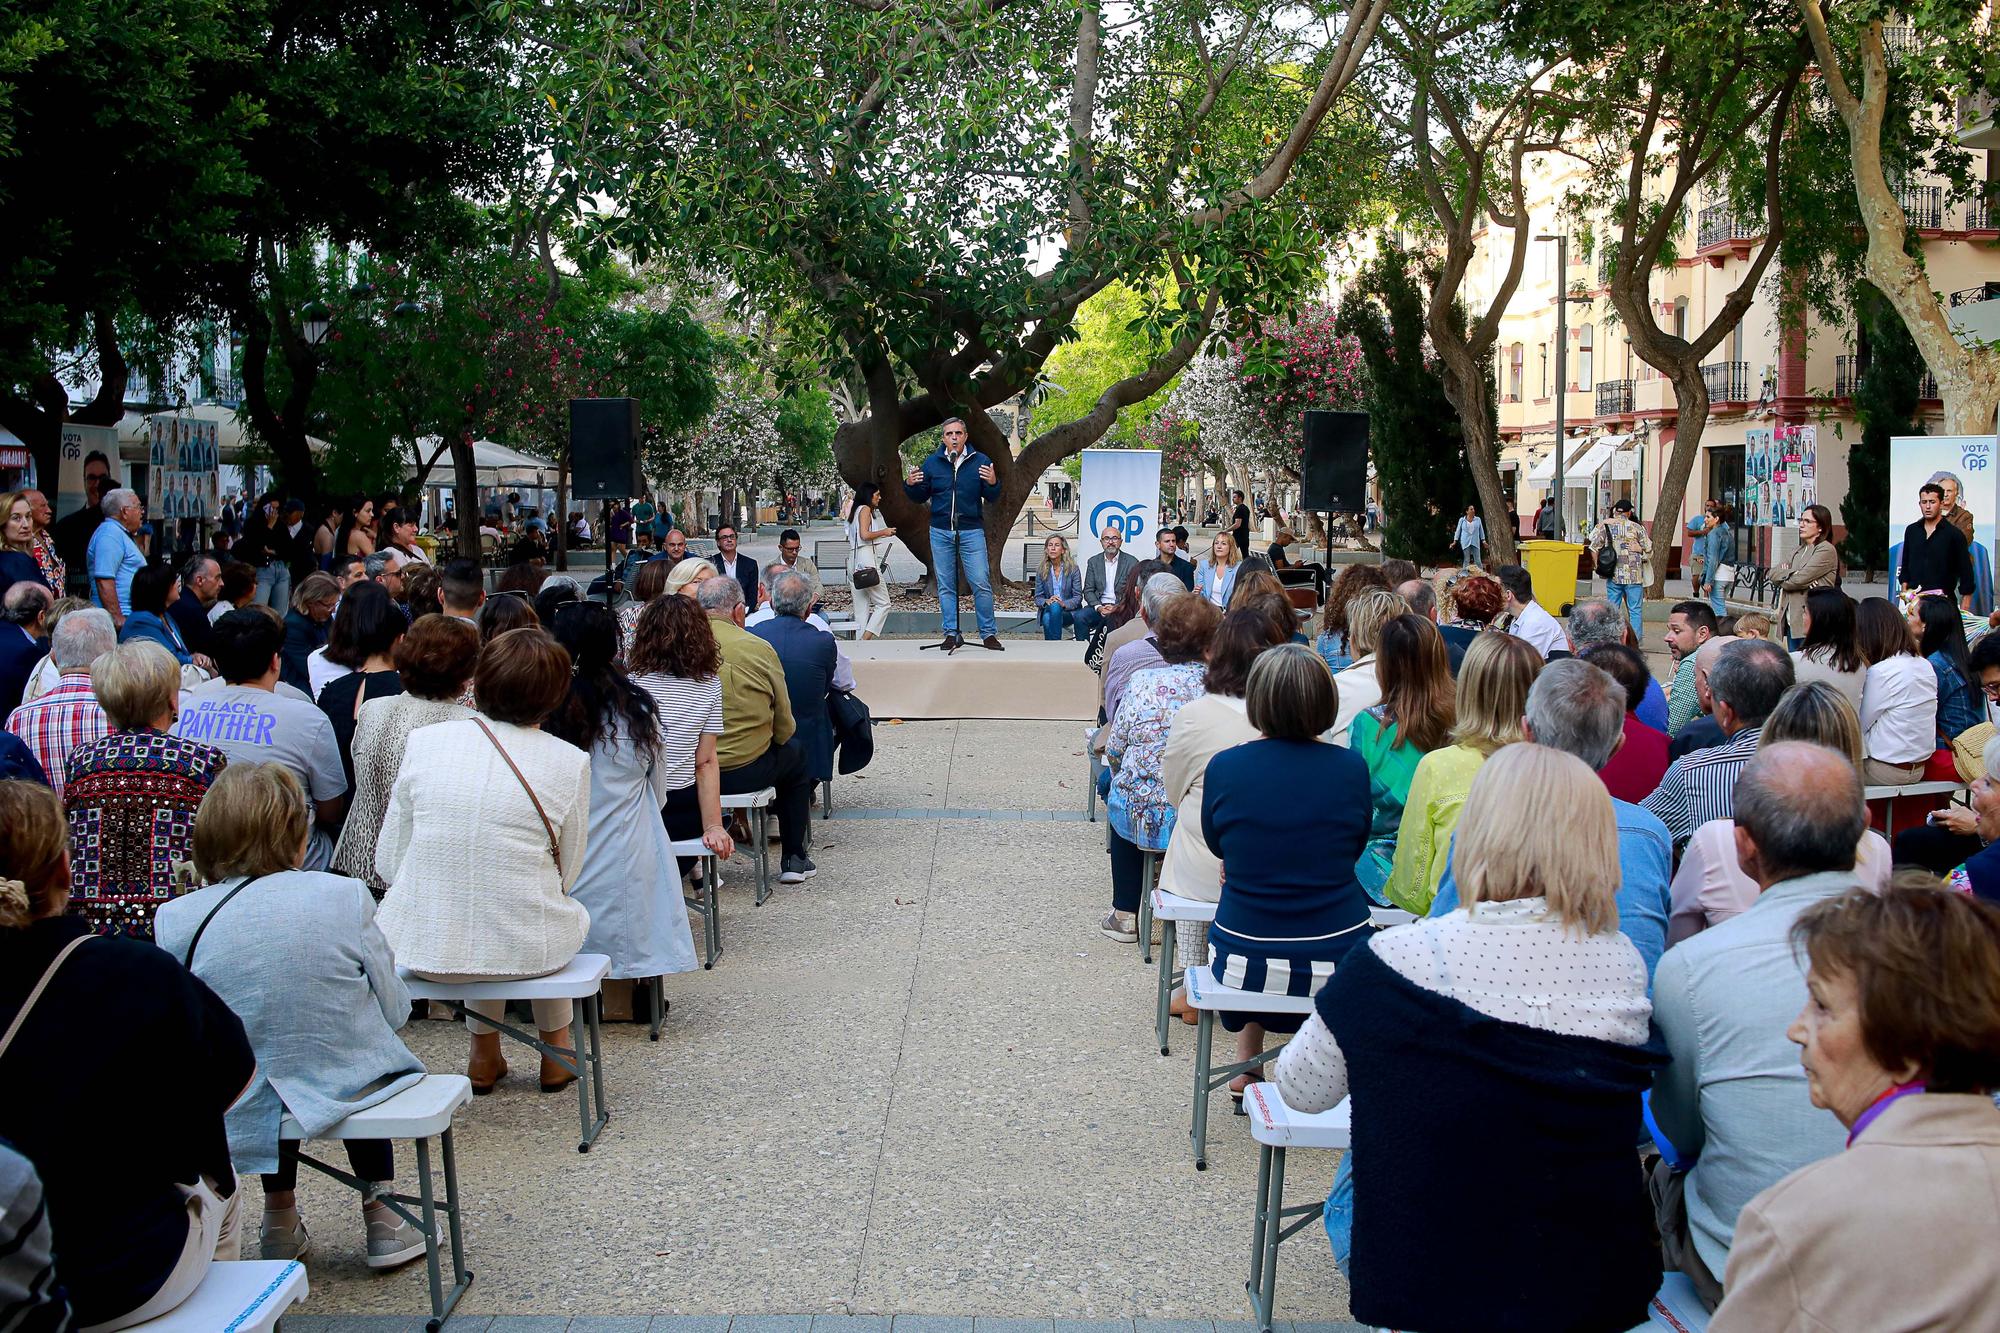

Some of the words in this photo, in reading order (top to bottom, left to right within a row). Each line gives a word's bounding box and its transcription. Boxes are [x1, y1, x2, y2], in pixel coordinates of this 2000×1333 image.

[63, 433, 82, 442] VOTA
[1961, 444, 1990, 453] VOTA
[199, 701, 257, 715] BLACK
[177, 708, 277, 746] PANTHER
